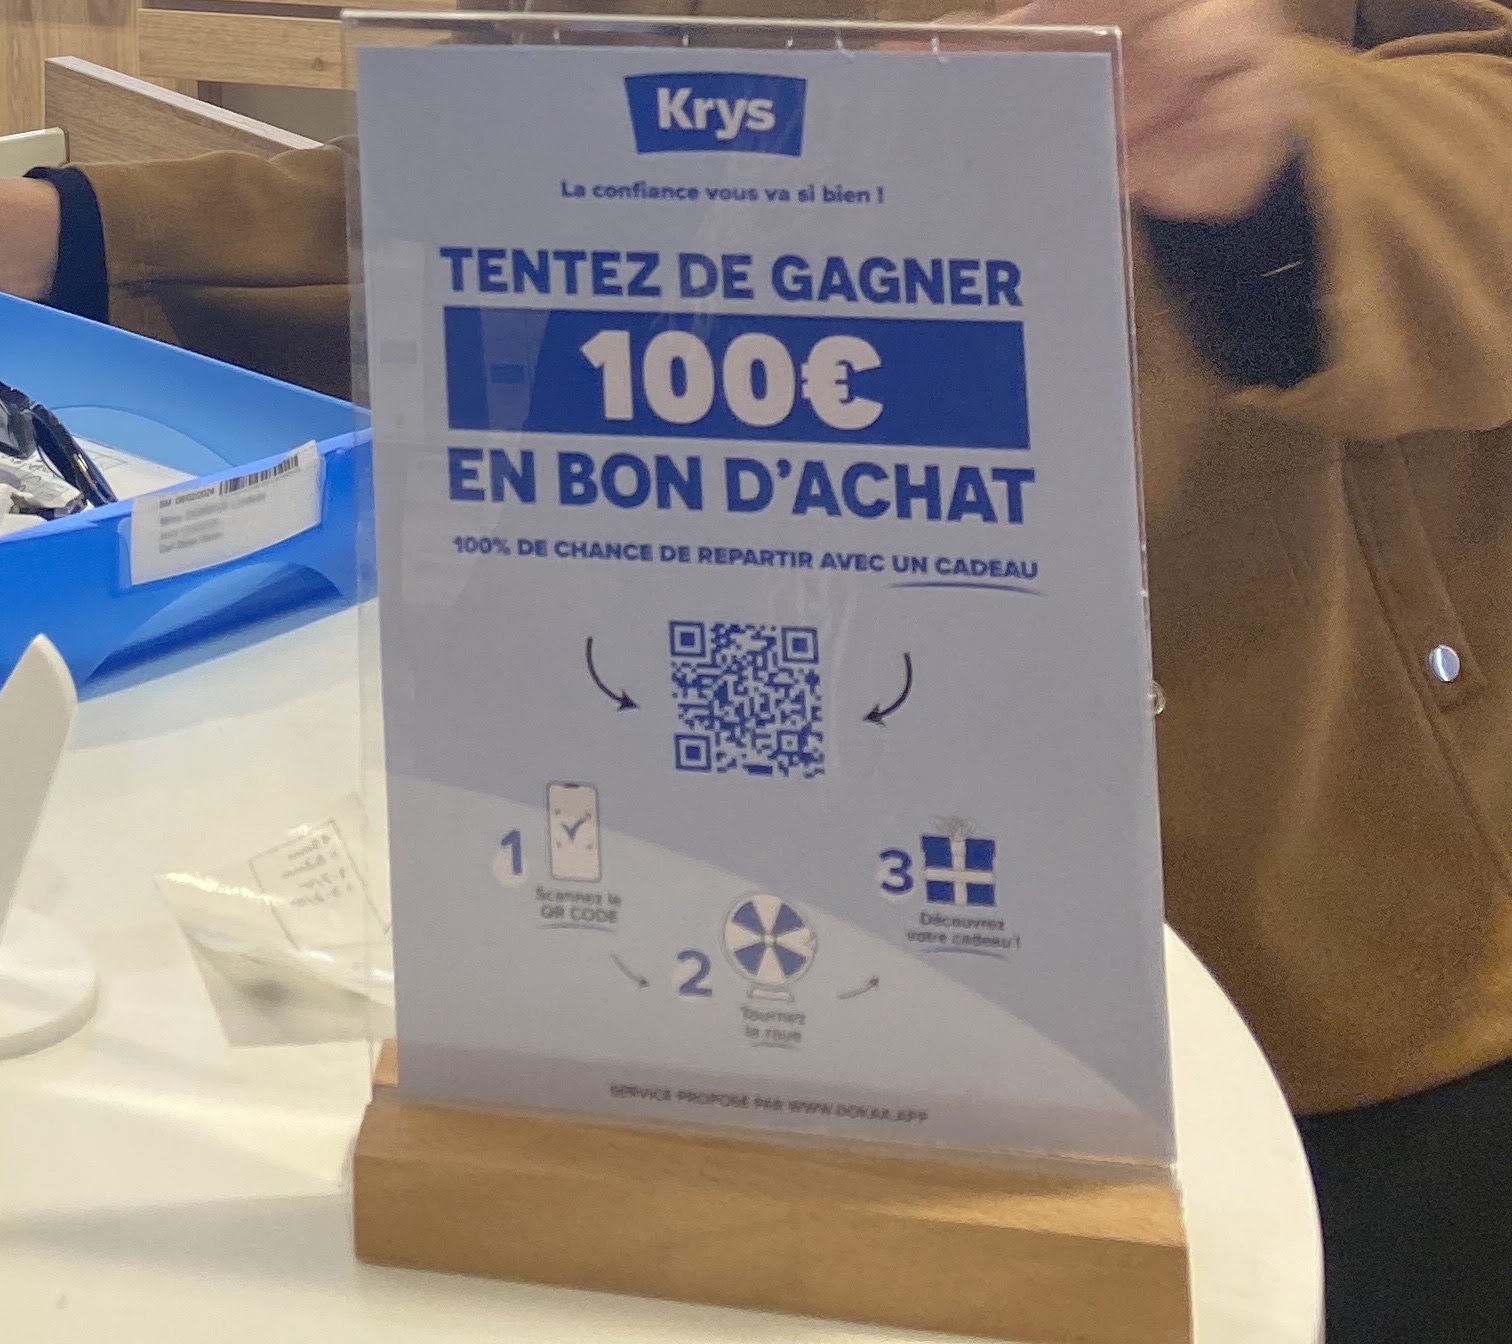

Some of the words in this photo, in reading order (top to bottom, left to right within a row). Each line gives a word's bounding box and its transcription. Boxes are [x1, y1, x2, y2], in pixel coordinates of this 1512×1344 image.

[656, 87, 776, 139] Krys
[561, 181, 587, 199] La
[592, 180, 699, 201] confiance
[705, 186, 758, 202] vous
[764, 187, 790, 203] va
[798, 183, 816, 203] si
[823, 184, 870, 204] bien
[440, 246, 661, 297] TENTEZ
[679, 252, 755, 301] DE
[772, 255, 1024, 307] GAGNER
[580, 329, 884, 431] 100€
[448, 447, 536, 504] EN
[558, 452, 704, 512] BON
[726, 458, 1036, 525] D'ACHAT
[453, 537, 511, 556] 100%
[517, 540, 548, 558] DE
[555, 541, 654, 562] CHANCE
[660, 545, 691, 563] DE
[698, 547, 813, 569] REPARTIR
[820, 553, 884, 573] AVEC
[892, 556, 928, 575] UN
[936, 557, 1038, 580] CADEAU
[500, 830, 524, 876] 1
[880, 849, 913, 895] 3
[569, 907, 618, 924] CODE
[919, 911, 1005, 931] Découvrez
[678, 950, 713, 997] 2
[610, 1084, 671, 1101] SERVICE
